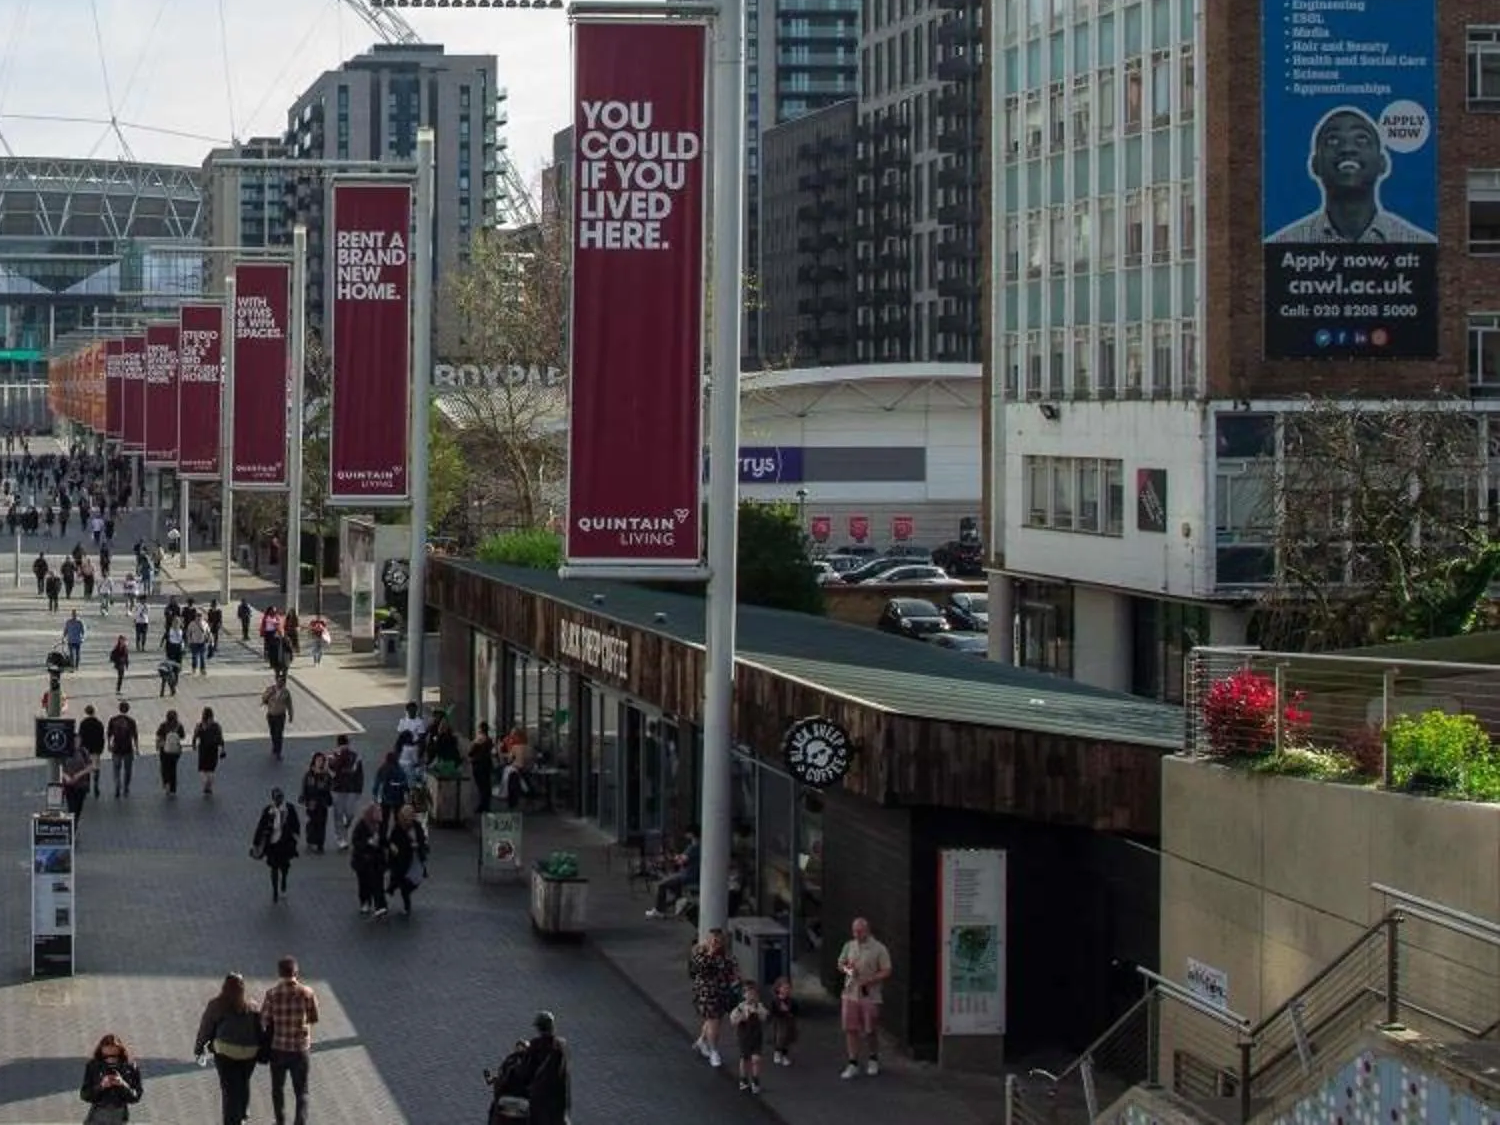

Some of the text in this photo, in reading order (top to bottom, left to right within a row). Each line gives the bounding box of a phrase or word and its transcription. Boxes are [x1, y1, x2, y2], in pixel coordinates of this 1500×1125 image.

[1292, 0, 1365, 11] Engineering
[1293, 28, 1330, 38] Media
[1293, 42, 1389, 53] Hair and Beauty
[1293, 56, 1426, 66] Health and Social Care
[1293, 70, 1339, 79] Science
[1294, 83, 1391, 94] Apprenticeships
[581, 101, 652, 130] YOU
[1383, 115, 1425, 126] APPLY
[1388, 128, 1421, 139] NOW
[581, 131, 699, 160] COULD
[581, 161, 685, 190] IF YOU
[580, 191, 671, 219] LIVED
[338, 232, 404, 248] RENT A
[580, 221, 670, 249] HERE.
[338, 250, 406, 266] BRAND
[1281, 251, 1420, 272] Apply now, at:
[338, 267, 381, 283] NEW
[1289, 273, 1413, 294] cnwl.ac.uk
[338, 283, 401, 300] HOME.
[238, 297, 267, 306] WITH
[238, 307, 272, 317] GYMS
[1280, 304, 1309, 316] Call:
[1313, 305, 1340, 316] 020
[1382, 305, 1417, 316] 5000
[237, 328, 284, 338] SPACES.
[337, 471, 393, 480] QUINTAIN
[578, 517, 675, 532] QUINTAIN
[620, 533, 675, 546] LIVING
